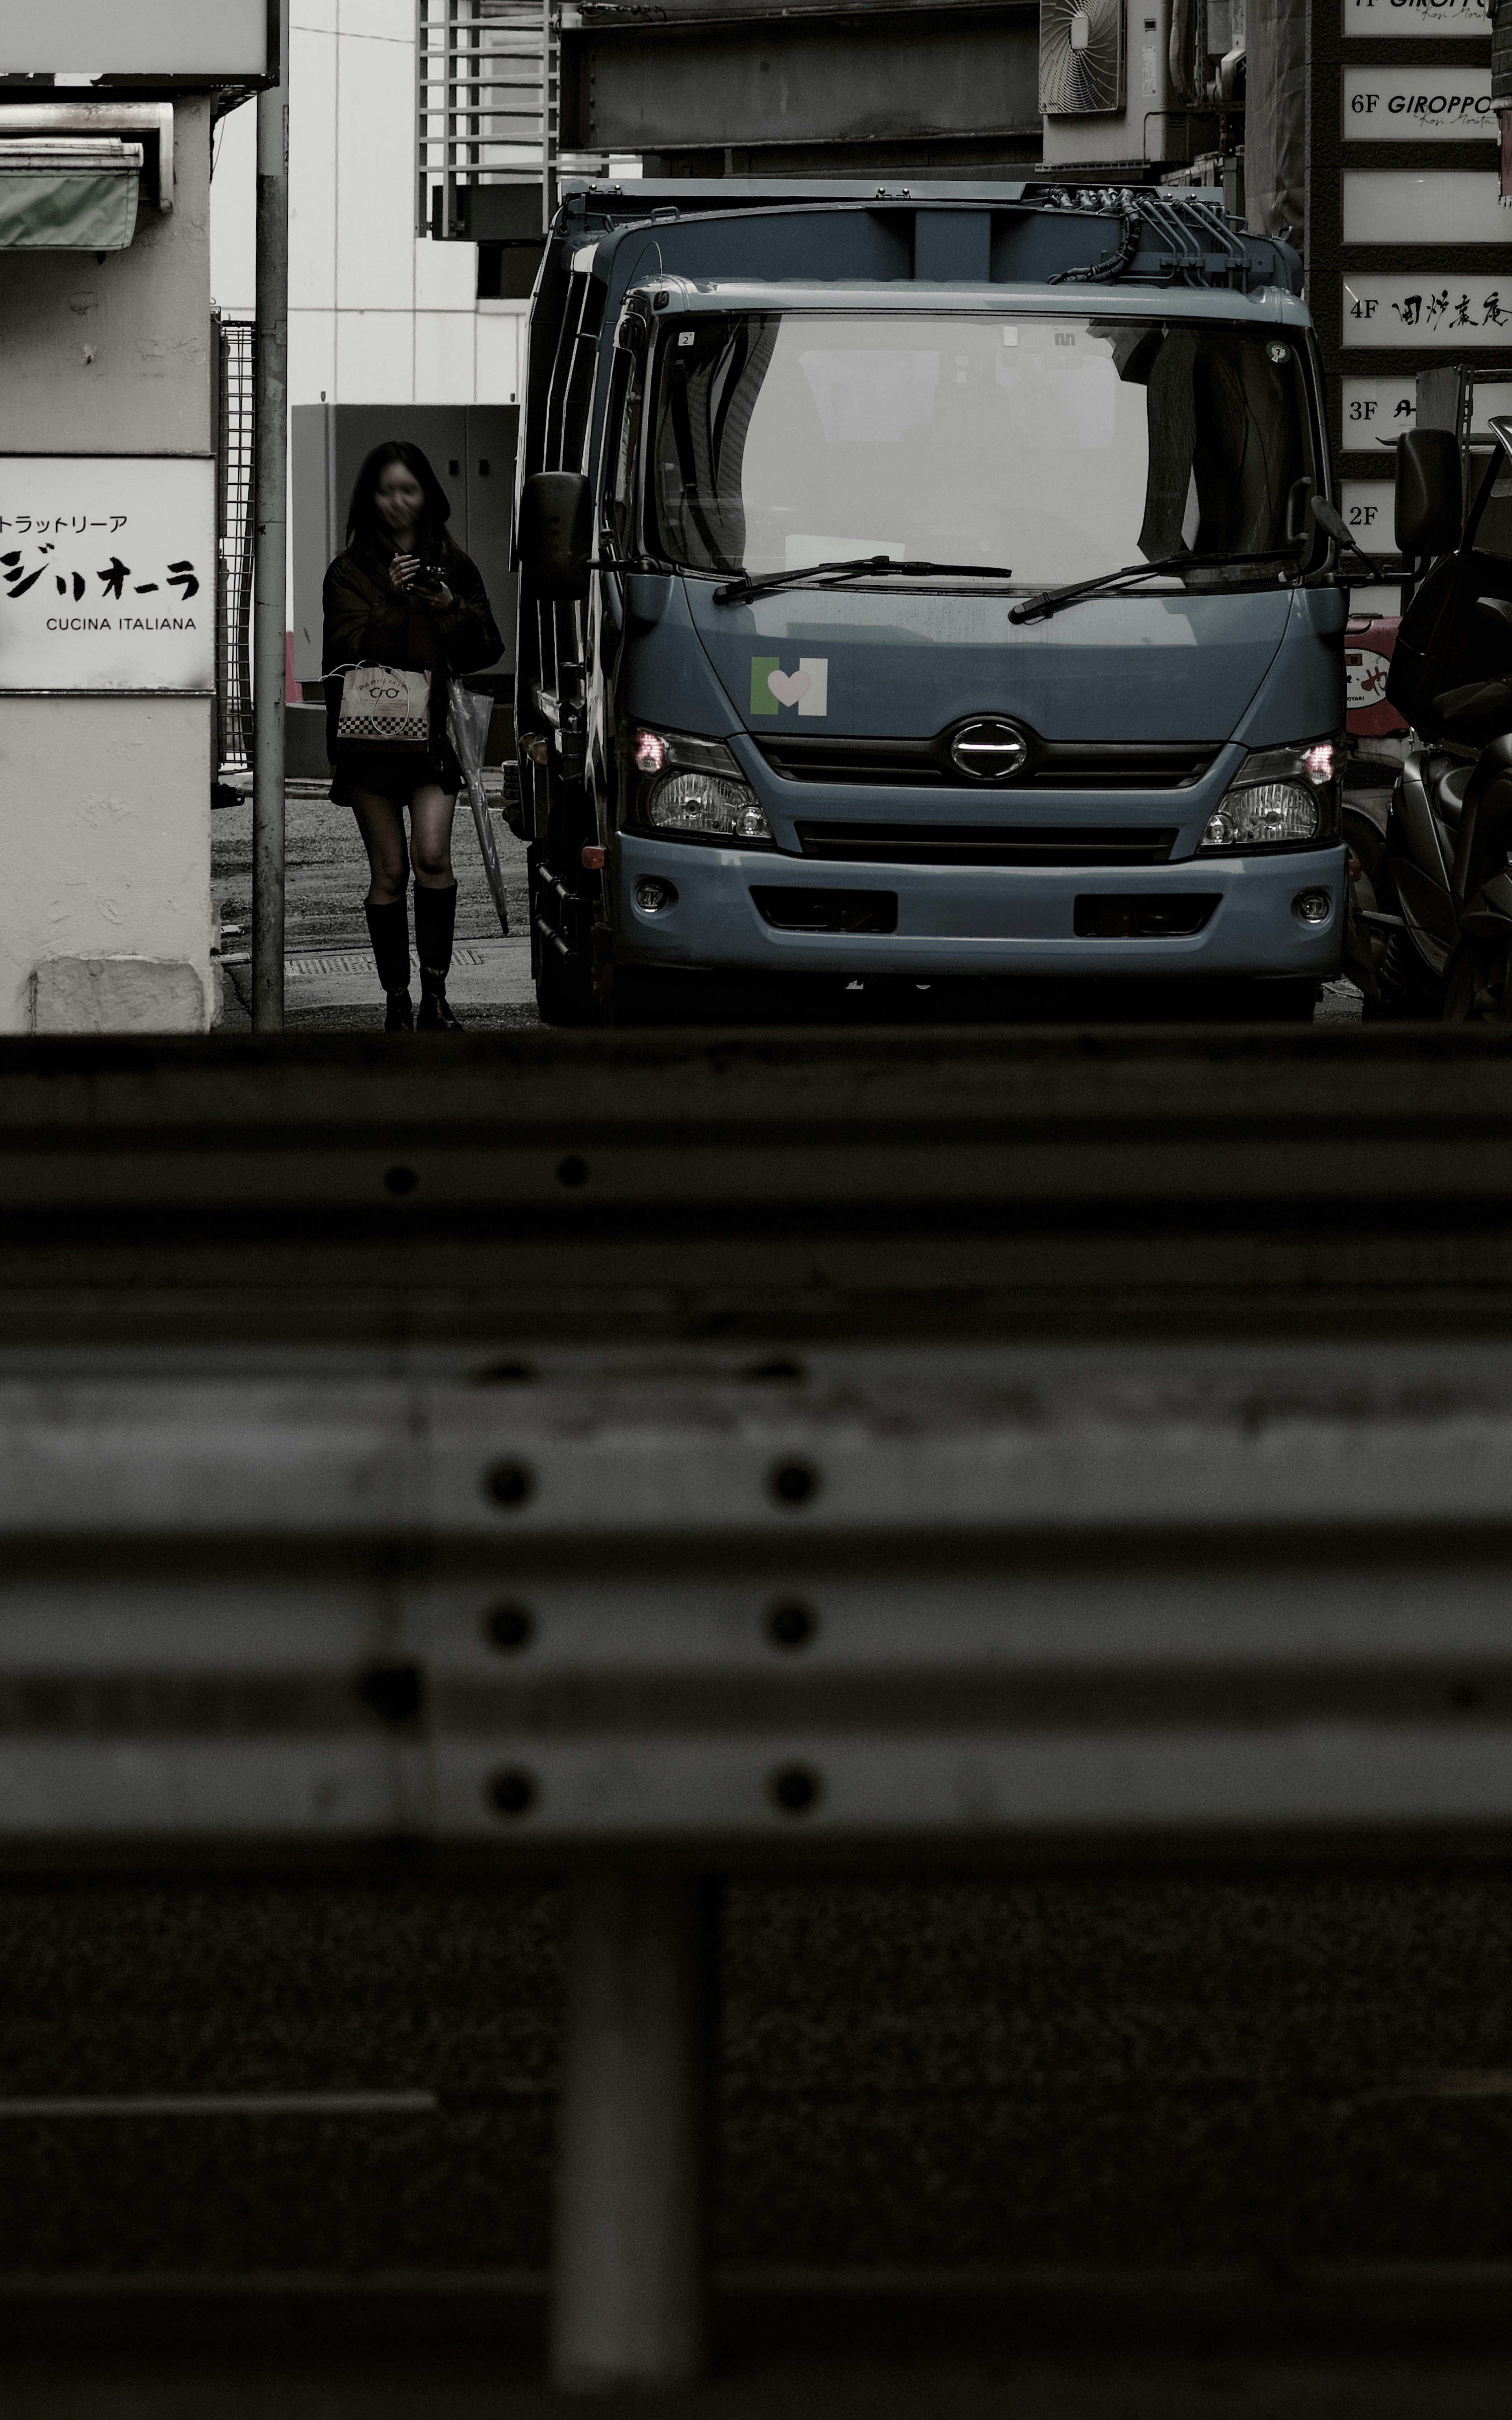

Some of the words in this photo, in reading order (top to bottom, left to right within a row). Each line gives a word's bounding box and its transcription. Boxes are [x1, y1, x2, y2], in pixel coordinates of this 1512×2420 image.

[1352, 95, 1380, 113] 6F
[1388, 95, 1496, 113] GIROPPO
[1351, 300, 1379, 318] 4F
[1350, 401, 1378, 420] 3F
[0, 516, 127, 533] トラットリーア
[1350, 507, 1378, 525] 2F
[0, 543, 200, 602] ジリオーラ
[46, 618, 111, 630] CUCINA
[119, 618, 196, 630] ITALIANA
